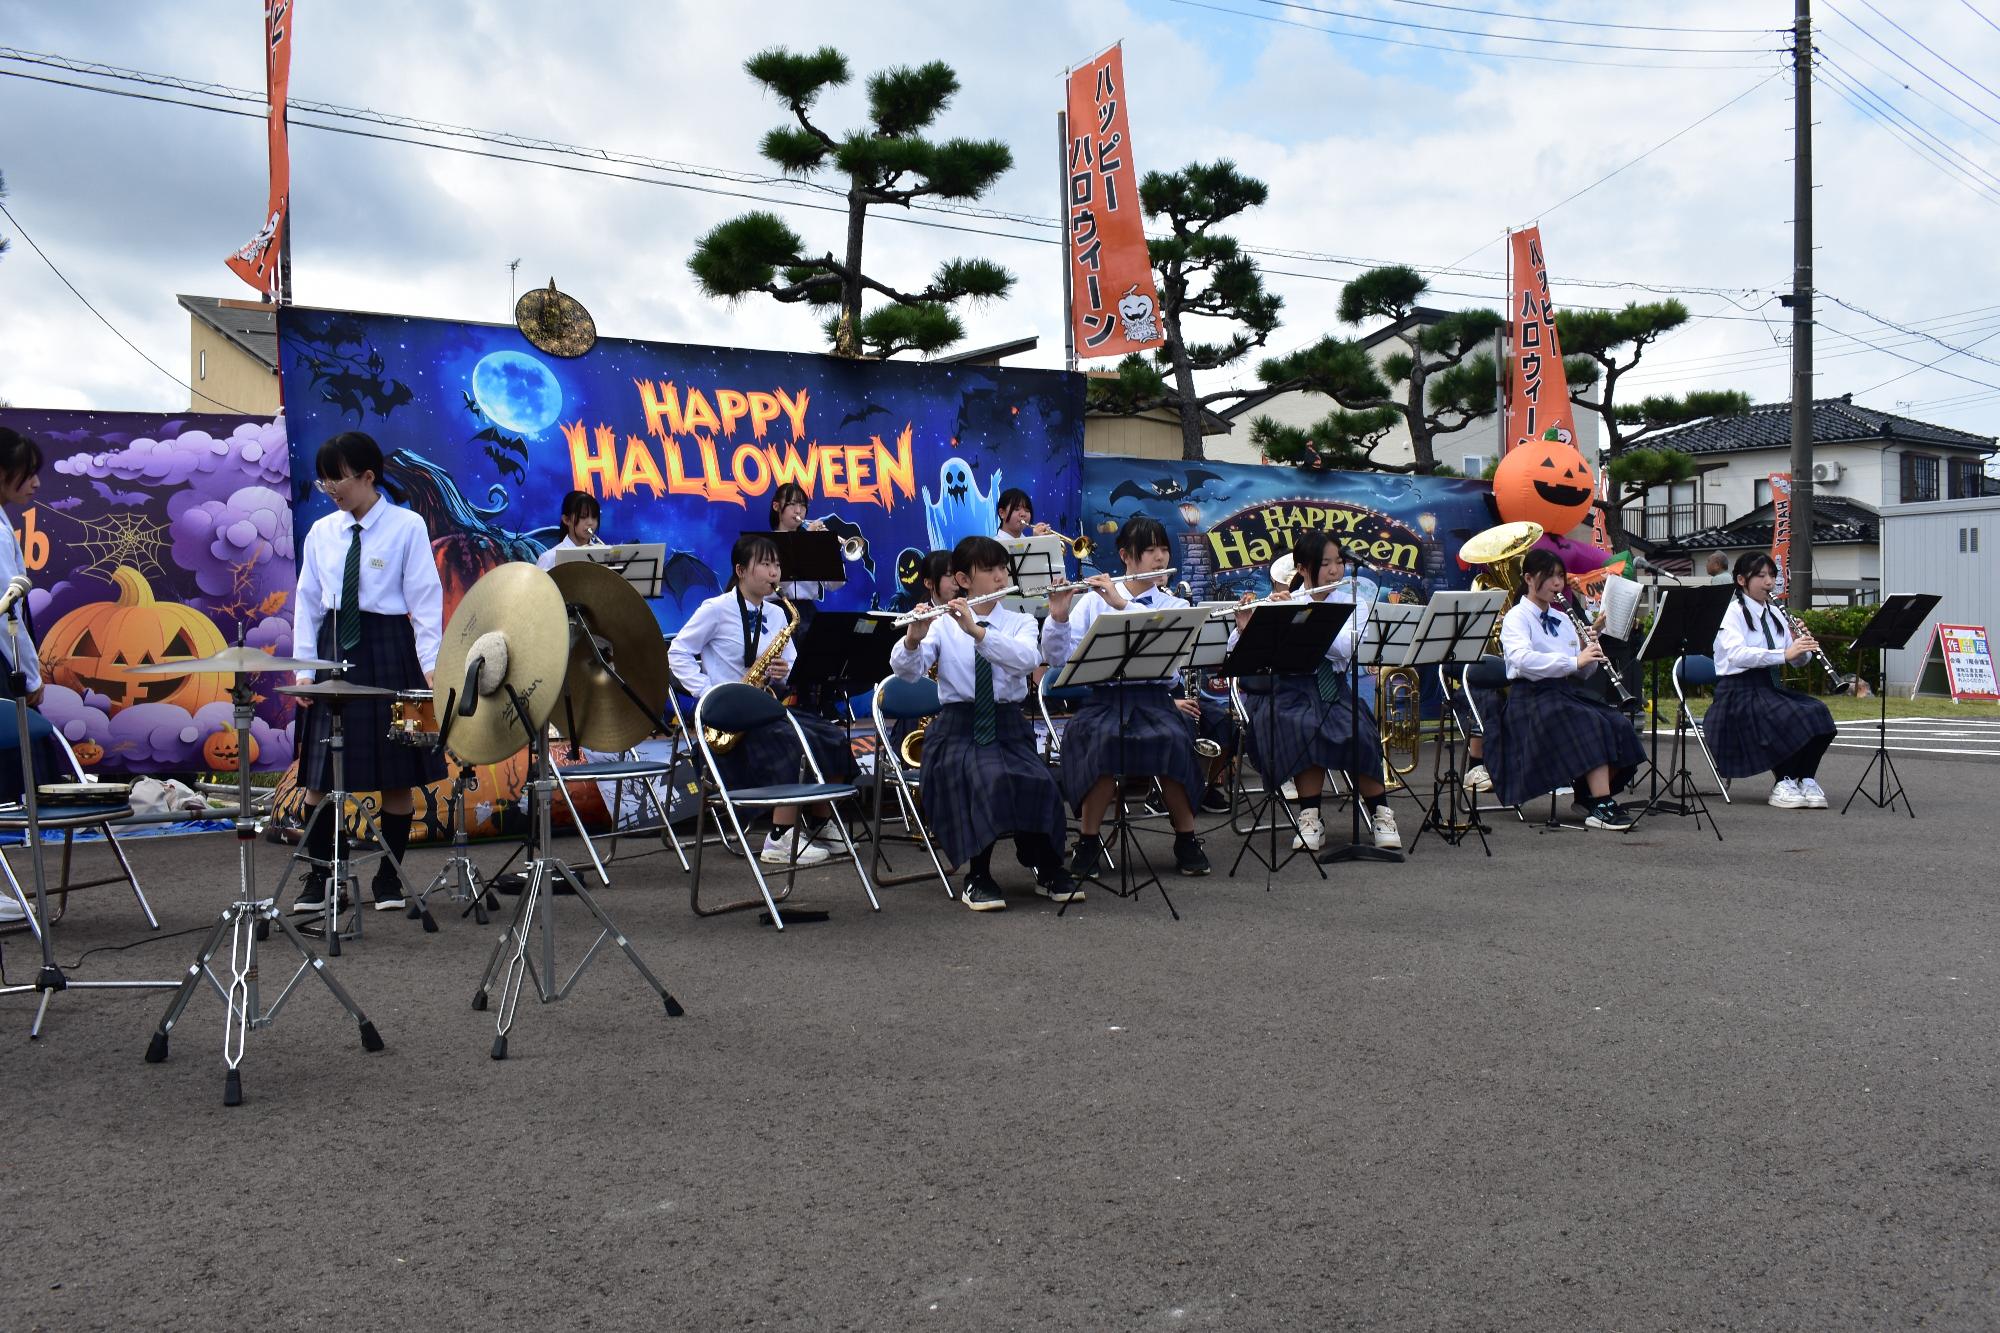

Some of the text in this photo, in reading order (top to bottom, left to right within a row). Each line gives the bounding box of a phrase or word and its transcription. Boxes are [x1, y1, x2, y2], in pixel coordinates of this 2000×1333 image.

[1094, 63, 1122, 213] ハッピー
[1517, 289, 1544, 446] ハロウィー
[633, 377, 811, 444] HAPPY
[559, 418, 917, 514] HALLOWEEN
[1260, 505, 1367, 532] HAPPY
[1947, 639, 1988, 654] 作品展
